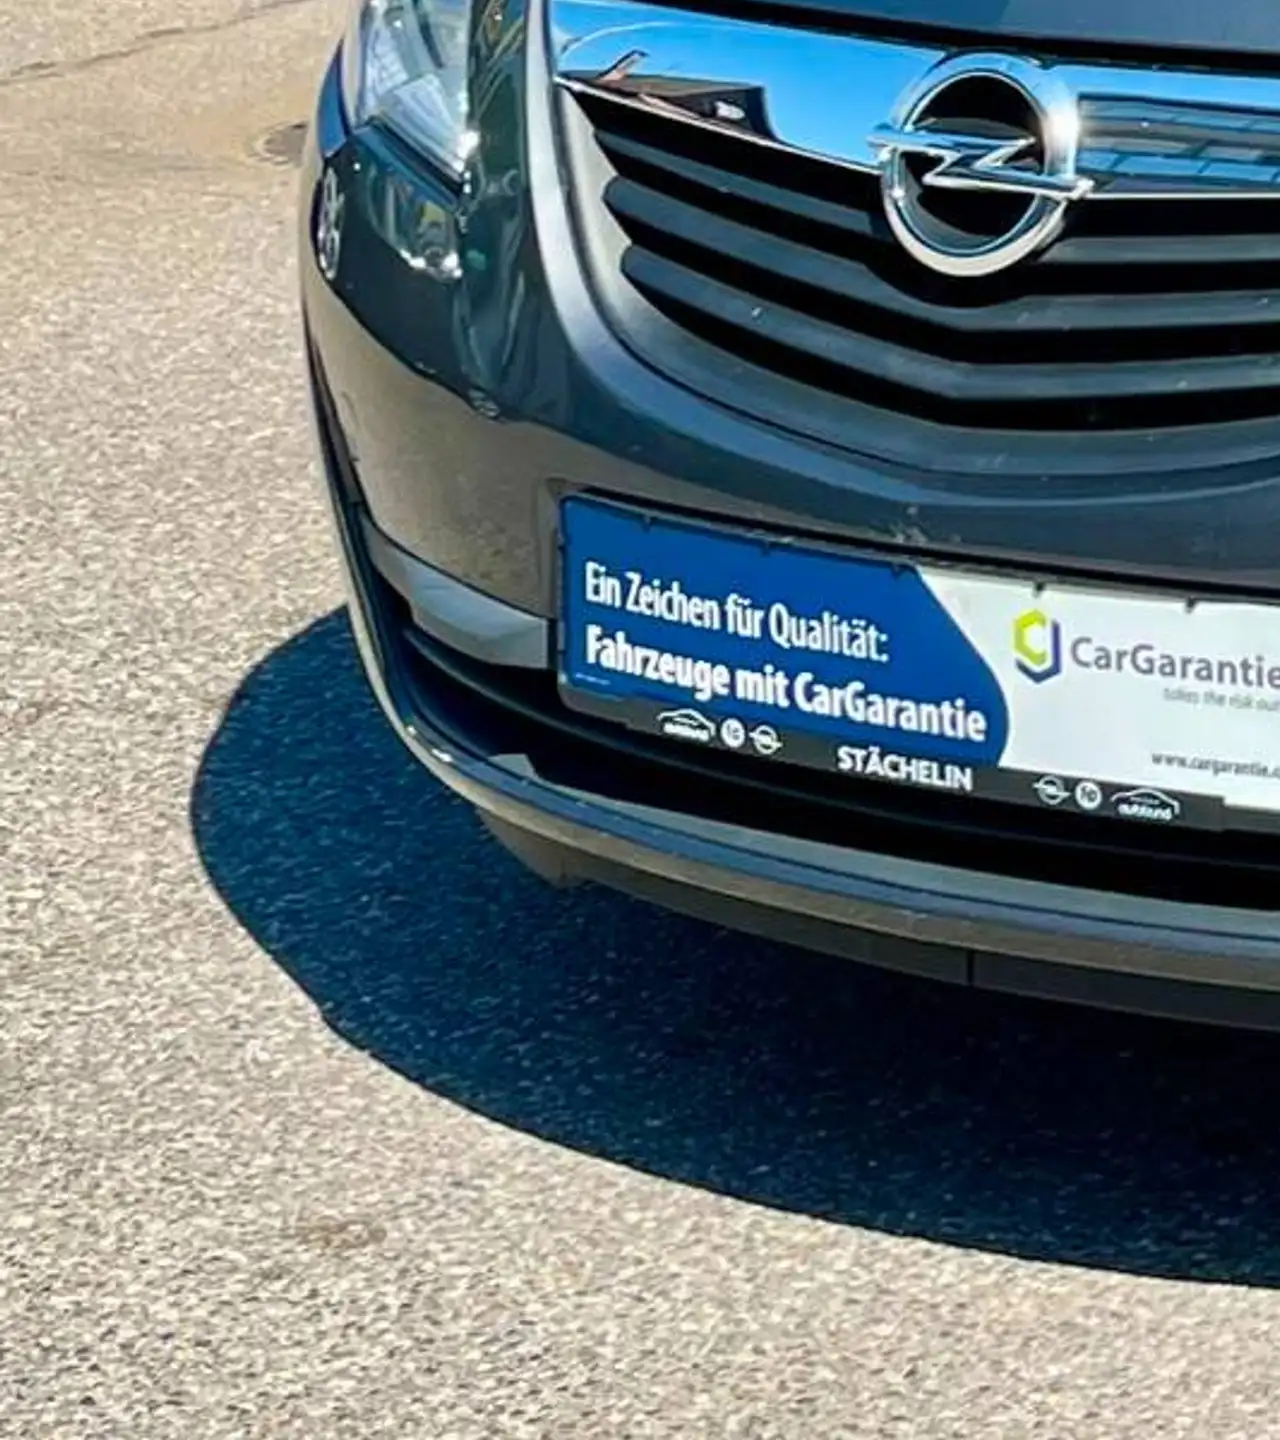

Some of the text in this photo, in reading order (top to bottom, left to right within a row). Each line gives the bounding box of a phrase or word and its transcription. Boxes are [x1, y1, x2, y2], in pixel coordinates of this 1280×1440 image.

[585, 560, 890, 663] Ein Zeichen für Qualität:
[586, 624, 731, 703] Fahrzeuge
[735, 663, 790, 708] mit
[793, 671, 988, 743] CarGarantie
[837, 744, 973, 792] STÄCHELIN
